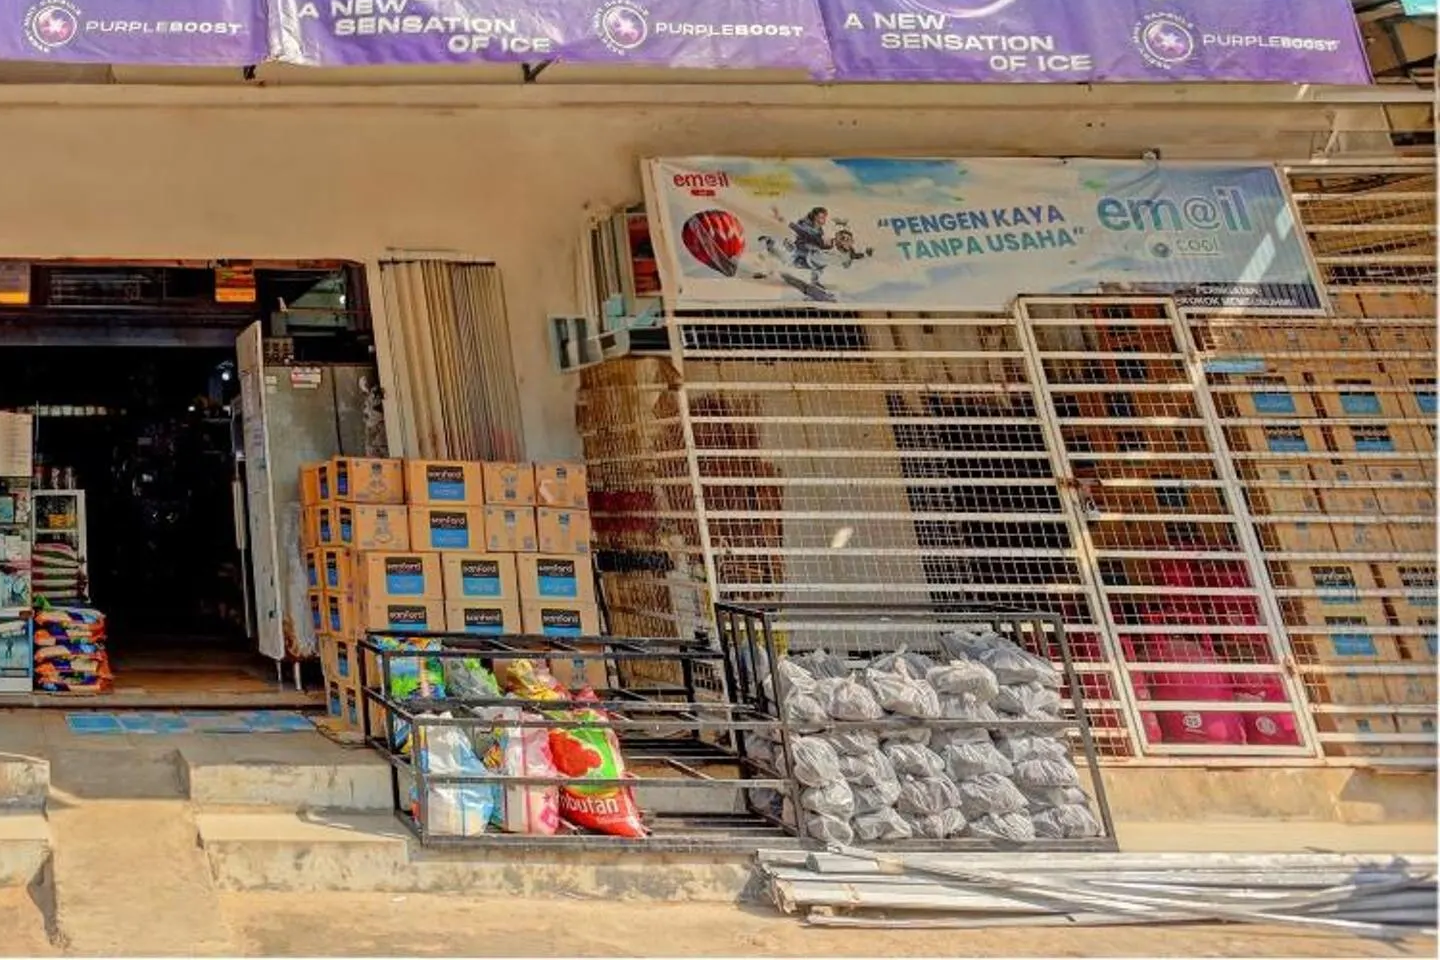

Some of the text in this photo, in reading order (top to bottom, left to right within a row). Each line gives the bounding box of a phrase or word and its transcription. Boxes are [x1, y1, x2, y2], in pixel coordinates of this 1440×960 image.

[298, 2, 319, 18] A
[334, 16, 517, 36] SENSATION
[655, 21, 804, 37] PURPLEBOOST
[844, 13, 945, 30] A NEW
[447, 35, 553, 53] OF ICE
[881, 33, 1054, 52] SENSATION
[990, 55, 1092, 72] OF ICE
[991, 205, 1065, 228] KAYA
[896, 236, 984, 260] TANPA
